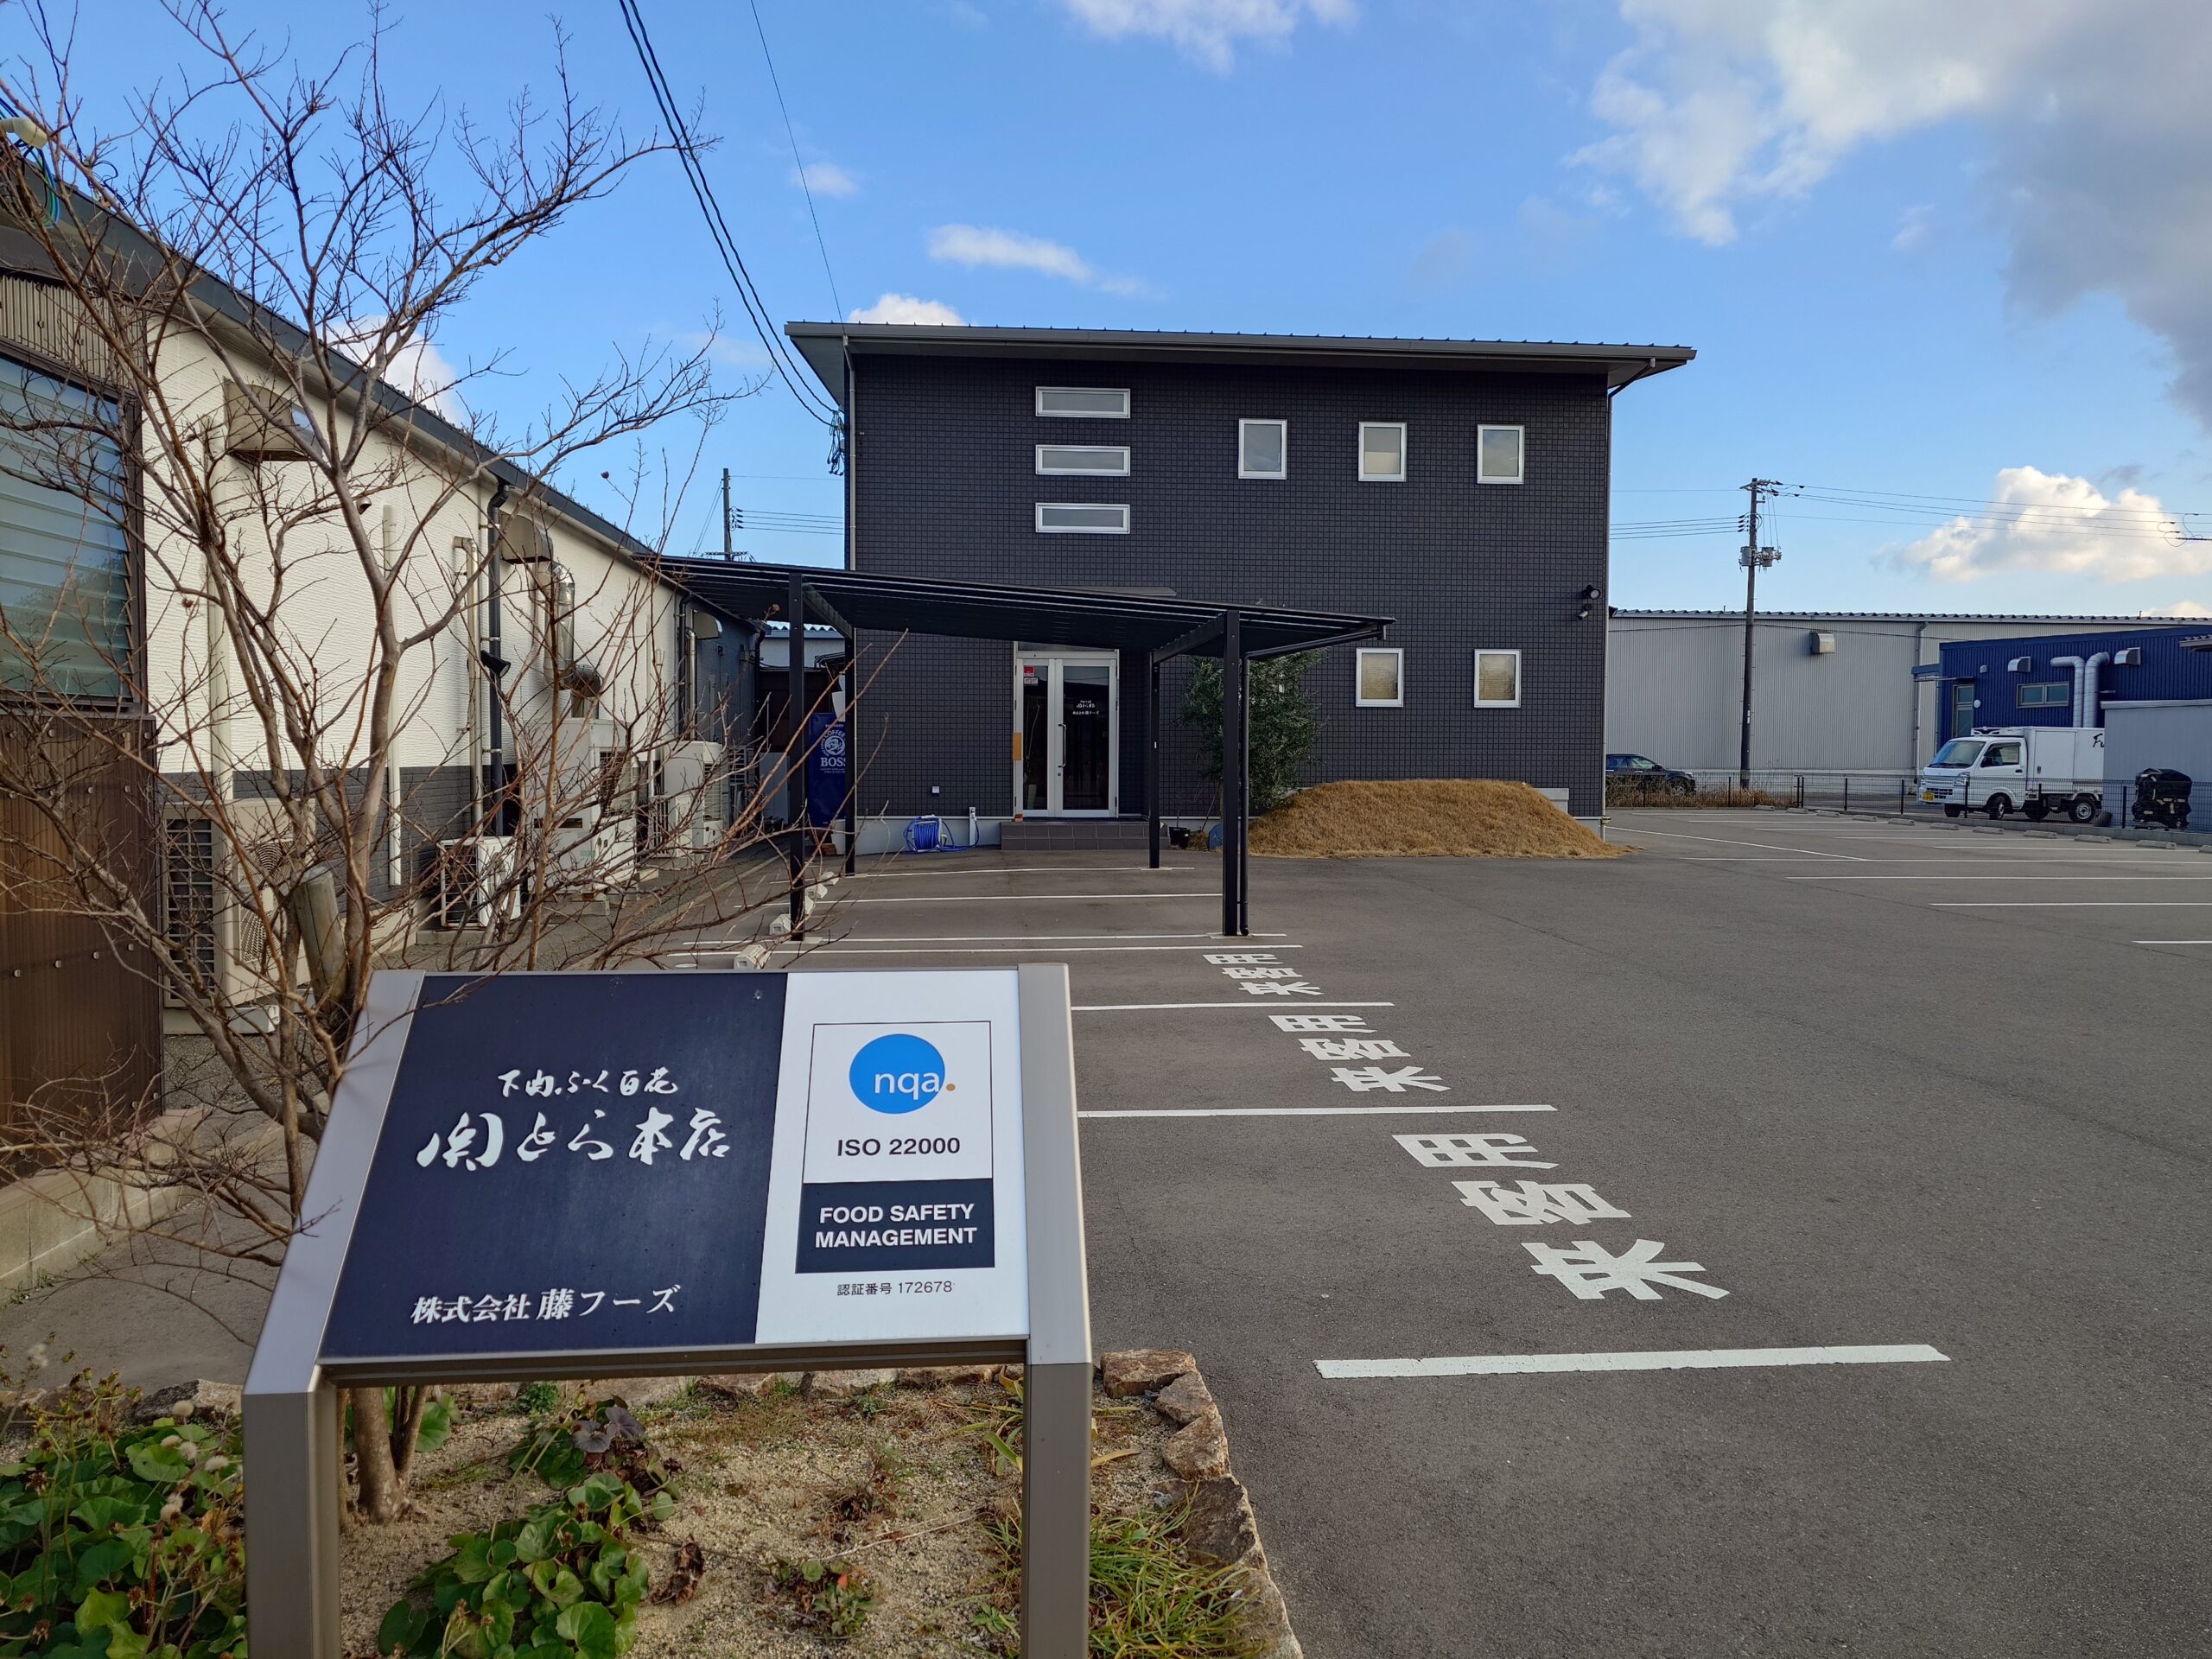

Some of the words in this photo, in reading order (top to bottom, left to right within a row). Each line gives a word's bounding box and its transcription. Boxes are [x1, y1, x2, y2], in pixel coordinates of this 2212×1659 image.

[837, 1138, 880, 1156] ISO
[889, 1137, 961, 1155] 22000
[819, 1206, 883, 1224] FOOD
[890, 1204, 975, 1222] SAFETY
[1392, 1133, 1731, 1300] 来客用
[815, 1227, 977, 1248] MANAGEMENT
[836, 1282, 893, 1296] 認証番号
[898, 1281, 953, 1294] 172678
